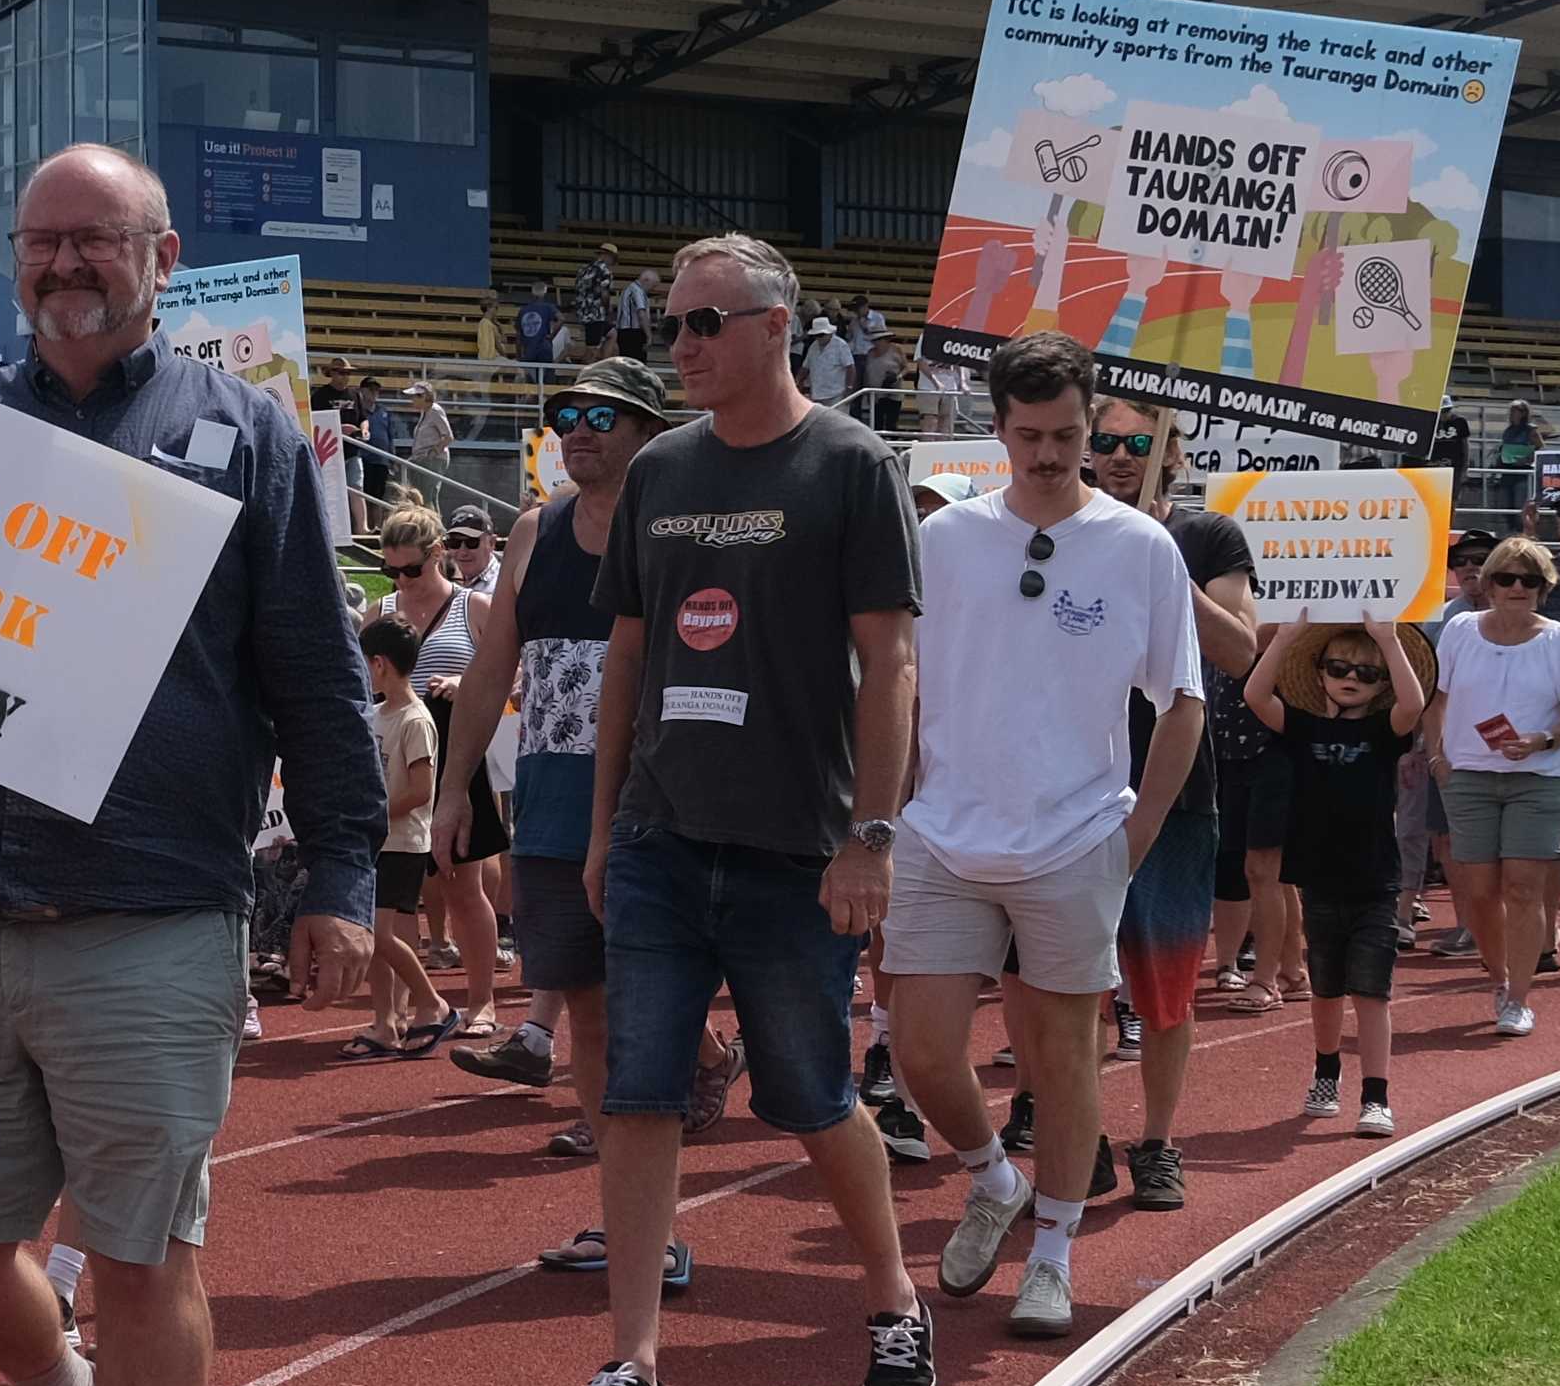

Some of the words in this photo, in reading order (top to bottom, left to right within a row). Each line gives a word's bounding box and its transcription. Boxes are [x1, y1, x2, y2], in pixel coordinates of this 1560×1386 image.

[1048, 0, 1066, 21] is
[1071, 1, 1139, 35] looking
[1146, 14, 1170, 32] at
[1175, 22, 1268, 52] removing
[1278, 26, 1310, 53] the
[1319, 35, 1378, 61] track
[1384, 41, 1427, 68] and
[1433, 44, 1492, 76] other
[1005, 24, 1109, 57] community
[1113, 40, 1178, 63] sports
[1184, 43, 1233, 70] from
[1240, 49, 1274, 74] the
[1282, 56, 1376, 92] Tauranga
[204, 141, 226, 154] Use
[228, 142, 241, 154] it!
[243, 143, 283, 158] Protect
[286, 146, 298, 159] it!
[1129, 130, 1234, 167] HANDS
[1247, 143, 1306, 175] OFF
[1126, 164, 1297, 215] TAURANGA
[1137, 204, 1287, 249] DOMAIN!
[195, 277, 210, 289] the
[214, 273, 239, 287] track
[243, 270, 260, 283] and
[263, 269, 290, 280] other
[156, 295, 179, 310] from
[182, 293, 196, 305] the
[200, 290, 243, 306] Tauranga
[246, 285, 279, 299] Domain
[198, 339, 223, 358] OFF
[943, 340, 992, 361] GOOGLE
[1310, 412, 1335, 430] FOR
[1340, 417, 1379, 437] MORE
[1383, 426, 1418, 445] INFO
[1244, 499, 1350, 522] HANDS
[1360, 497, 1416, 520] OFF
[651, 512, 783, 536] COLLINS
[4, 501, 126, 580] OFF
[705, 528, 778, 546] Racing
[1261, 537, 1395, 558] BAYPARK
[1253, 578, 1399, 602] SPEEDWAY
[683, 613, 732, 626] Baypark
